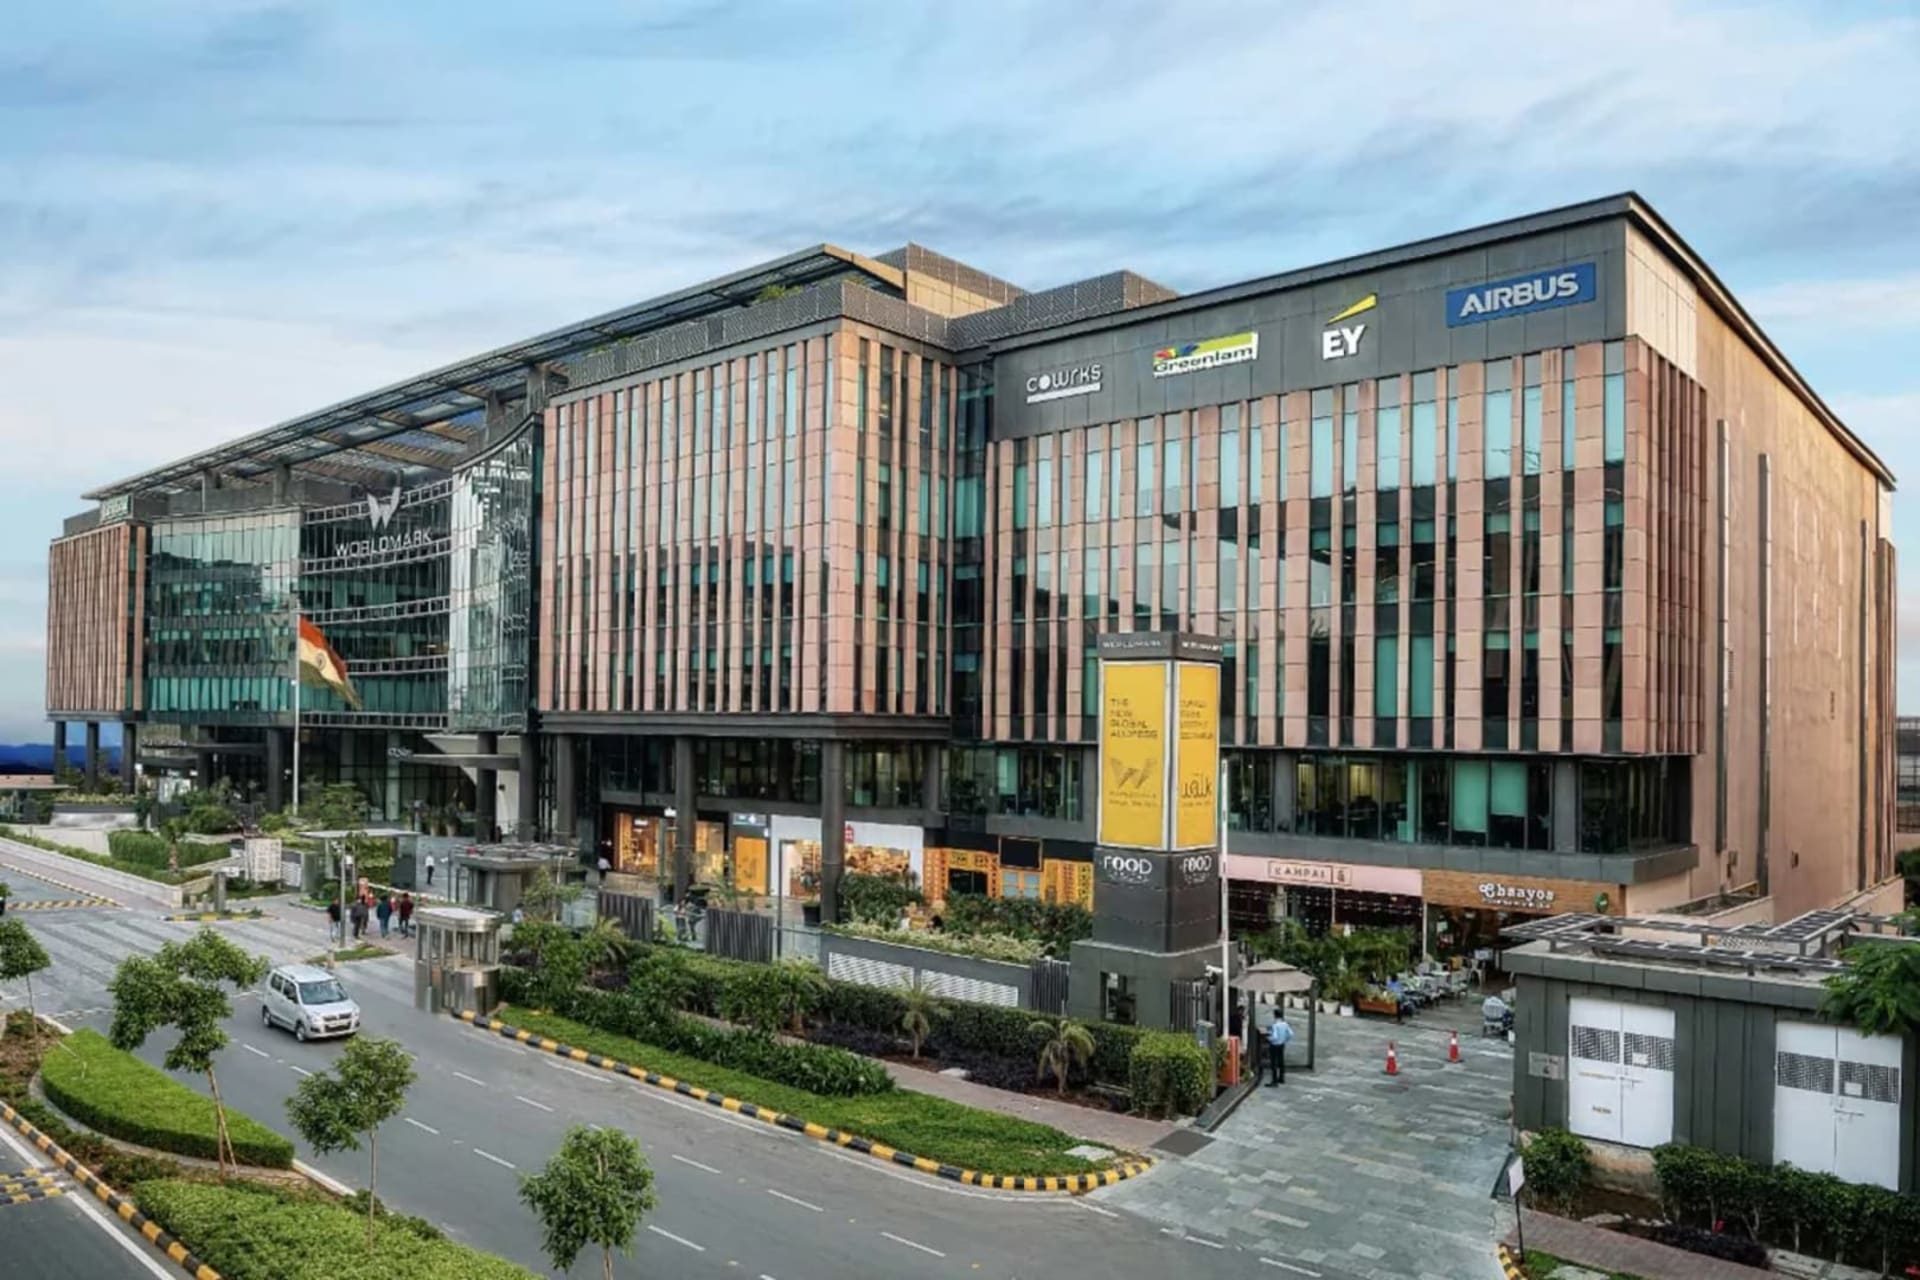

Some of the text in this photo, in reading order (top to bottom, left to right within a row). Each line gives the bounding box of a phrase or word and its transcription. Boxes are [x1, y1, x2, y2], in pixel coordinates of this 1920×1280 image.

[1460, 273, 1579, 317] AIRBUS
[1323, 324, 1366, 360] EY
[1153, 347, 1253, 372] Greenlam
[335, 527, 433, 558] WORLDMARK
[1104, 856, 1152, 875] FOOD
